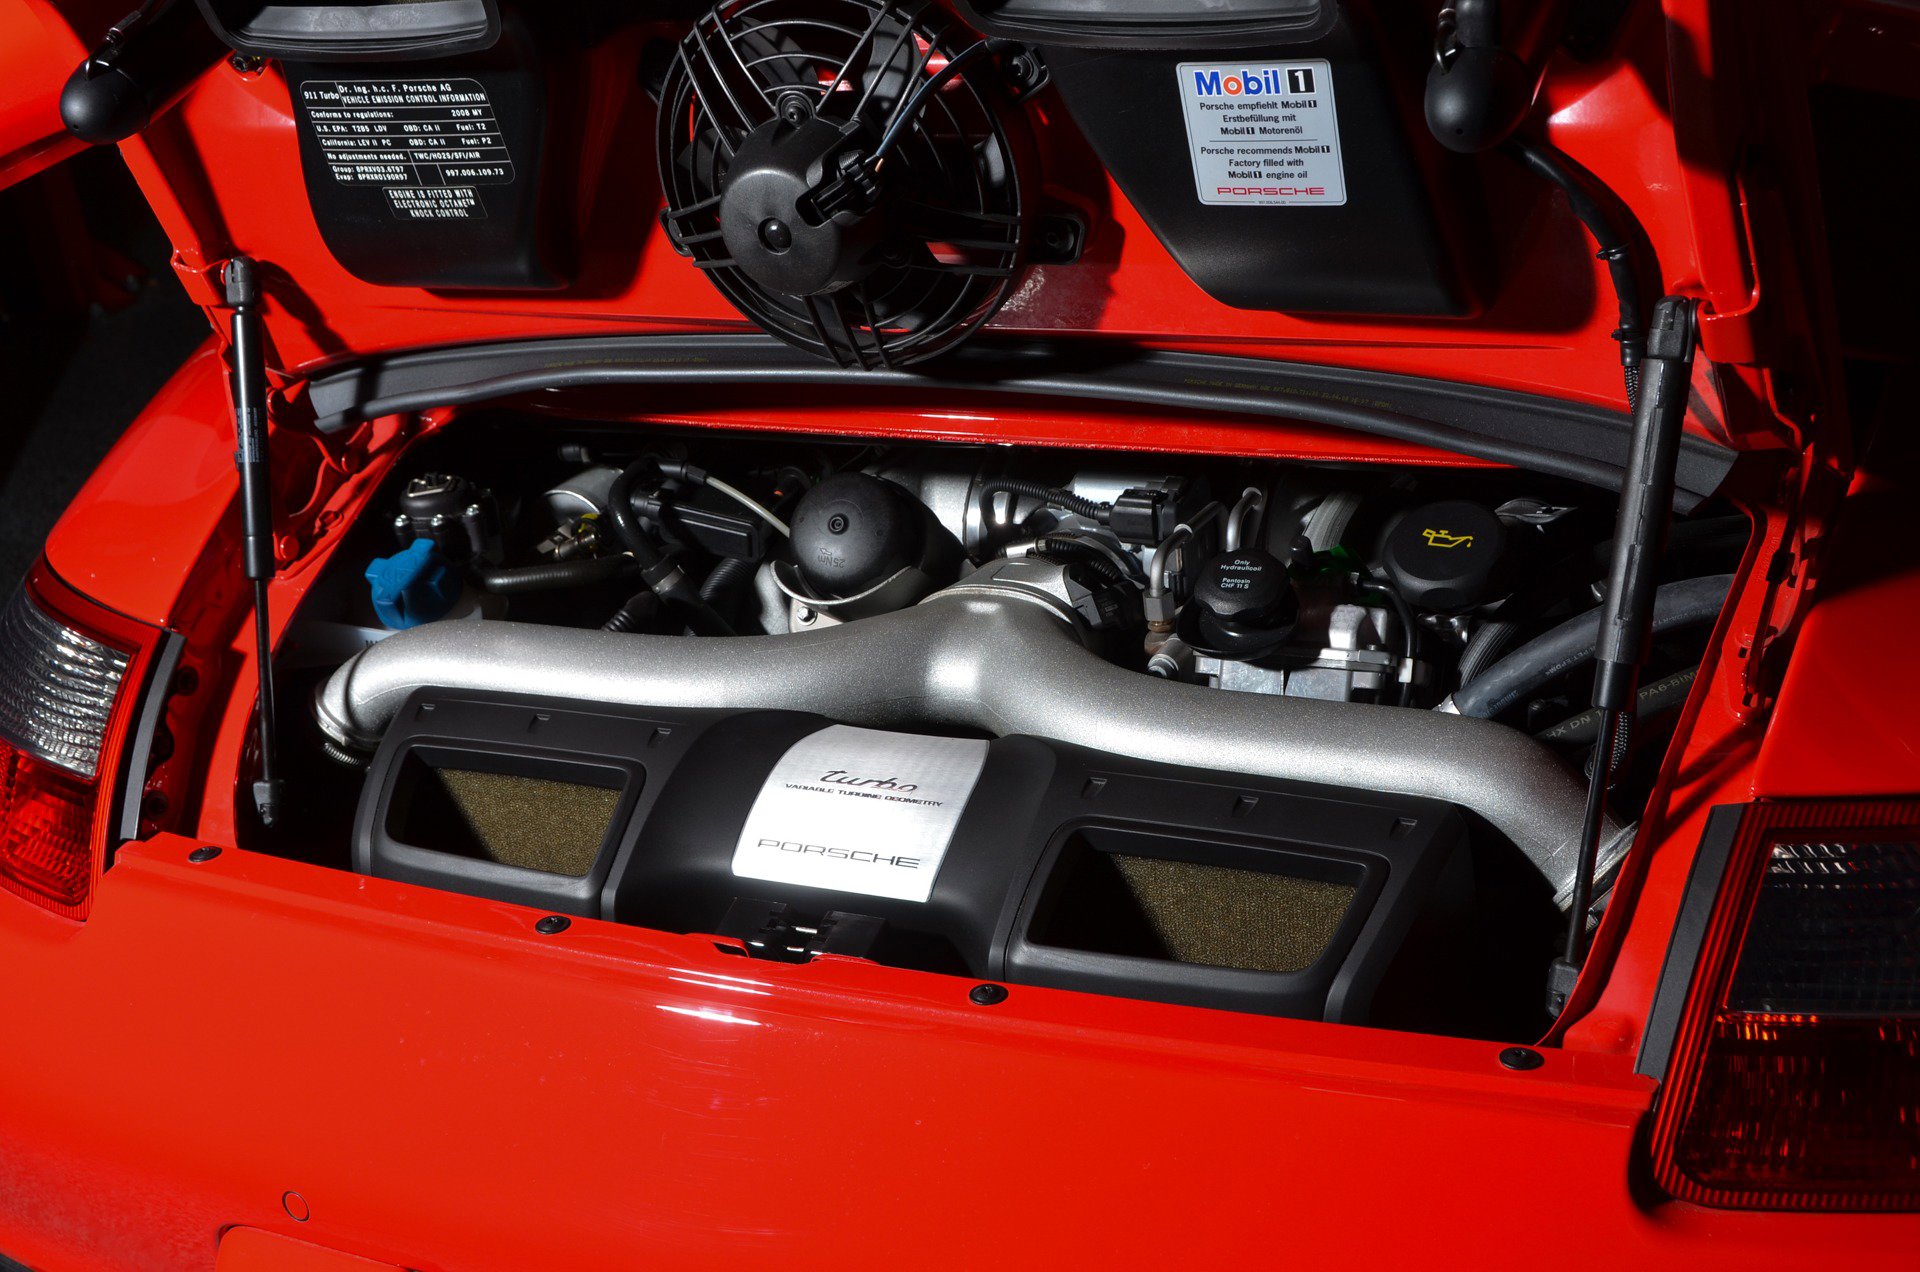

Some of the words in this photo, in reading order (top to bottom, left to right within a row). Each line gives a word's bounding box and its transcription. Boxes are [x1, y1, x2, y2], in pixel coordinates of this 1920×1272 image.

[1195, 70, 1280, 96] Mobil
[339, 85, 352, 93] Dr.
[354, 85, 370, 94] Ing.
[373, 85, 390, 93] h.c.
[392, 84, 401, 92] F.
[403, 84, 438, 92] Porsche
[304, 92, 318, 100] 911
[320, 91, 340, 100] Turbo
[343, 95, 370, 104] VEHICLE
[372, 95, 404, 103] EMISSION
[406, 94, 437, 103] CONTROL
[440, 93, 485, 102] INFORMATION
[1238, 102, 1278, 111] empfiehlt
[311, 110, 341, 119] Conforms
[353, 110, 393, 119] regulations:
[451, 109, 470, 117] 2008
[1223, 114, 1279, 123] Erstbefüllung
[1282, 114, 1296, 122] mit
[317, 125, 331, 133] U.S.
[333, 125, 348, 133] EPA:
[375, 124, 387, 132] LDV
[404, 124, 421, 132] OBD:
[456, 123, 474, 131] Fuel:
[1259, 126, 1302, 134] Motorenöl
[321, 138, 356, 147] California:
[358, 138, 371, 146] LEV
[382, 138, 392, 146] PC
[409, 138, 426, 146] OBD:
[461, 137, 479, 145] Fuel:
[327, 152, 337, 160] No
[339, 152, 378, 162] adjustments
[380, 152, 406, 160] needed.
[1229, 159, 1260, 168] Factory
[332, 165, 354, 174] Group:
[335, 173, 354, 181] Evap:
[1266, 172, 1294, 180] engine
[389, 190, 414, 199] ENGINE
[417, 190, 425, 199] IS
[427, 190, 452, 199] FITTED
[454, 189, 473, 198] WITH
[1218, 187, 1325, 195] PORSCHE
[394, 200, 438, 209] ELECTRONIC
[410, 209, 435, 218] KNOCK
[436, 209, 468, 218] CONTROL
[1569, 715, 1591, 730] DN
[820, 770, 918, 793] turbo
[786, 783, 834, 794] VARIABLE
[838, 790, 881, 800] TURBINE
[884, 795, 943, 807] GEOMETRY
[757, 838, 921, 869] PORSCHE
